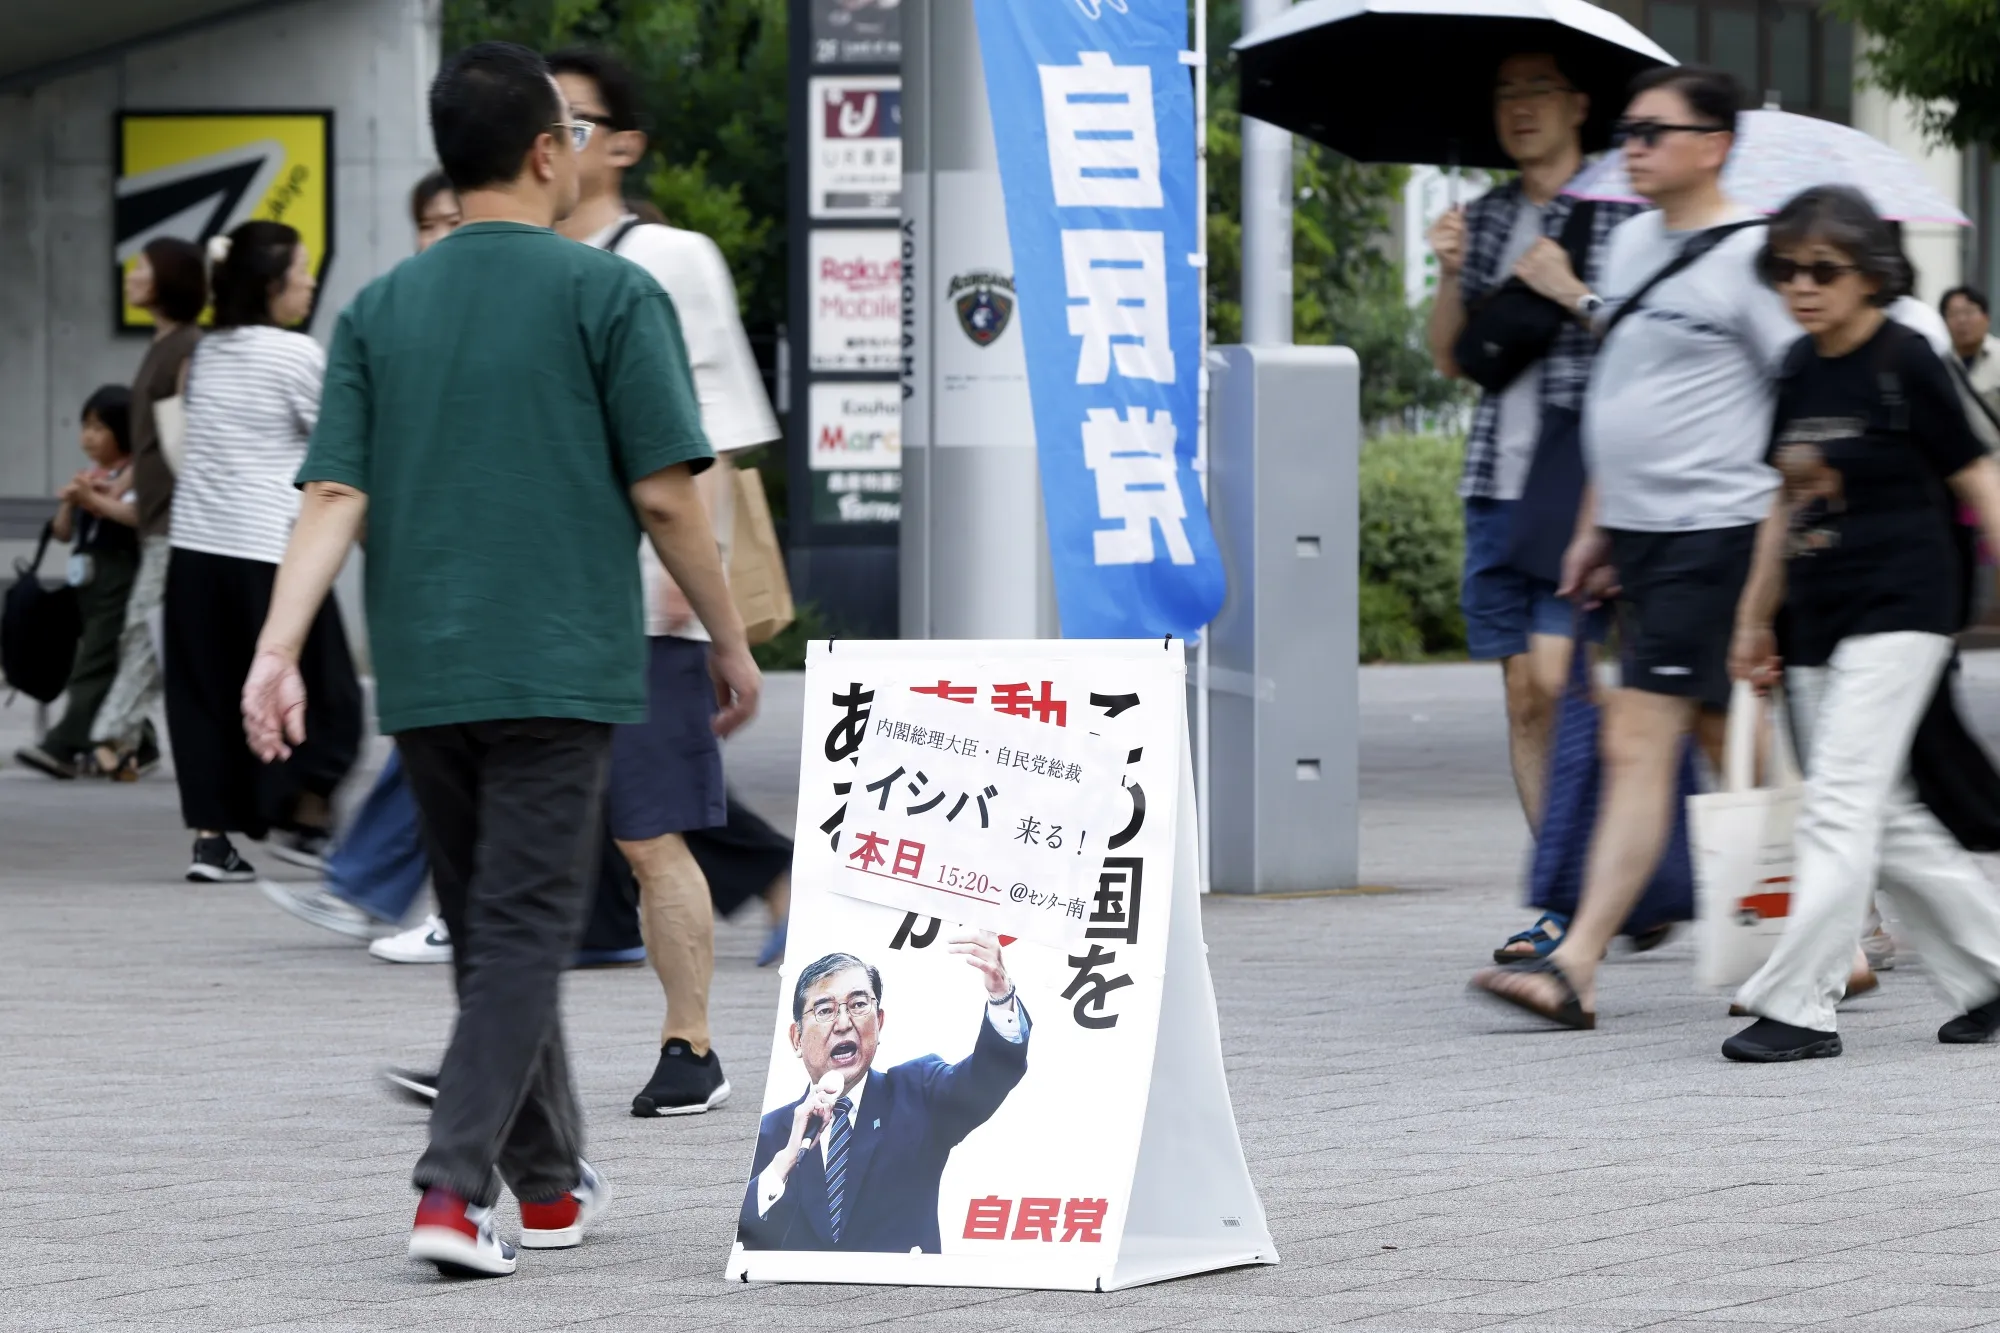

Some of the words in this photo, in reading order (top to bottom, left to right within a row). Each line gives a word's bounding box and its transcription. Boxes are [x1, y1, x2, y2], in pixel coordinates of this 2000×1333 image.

[876, 718, 1083, 783] 内閣総理大臣・自民党総裁
[865, 765, 998, 829] イシバ
[850, 830, 926, 879] 本日
[962, 1195, 1108, 1242] 自民党
